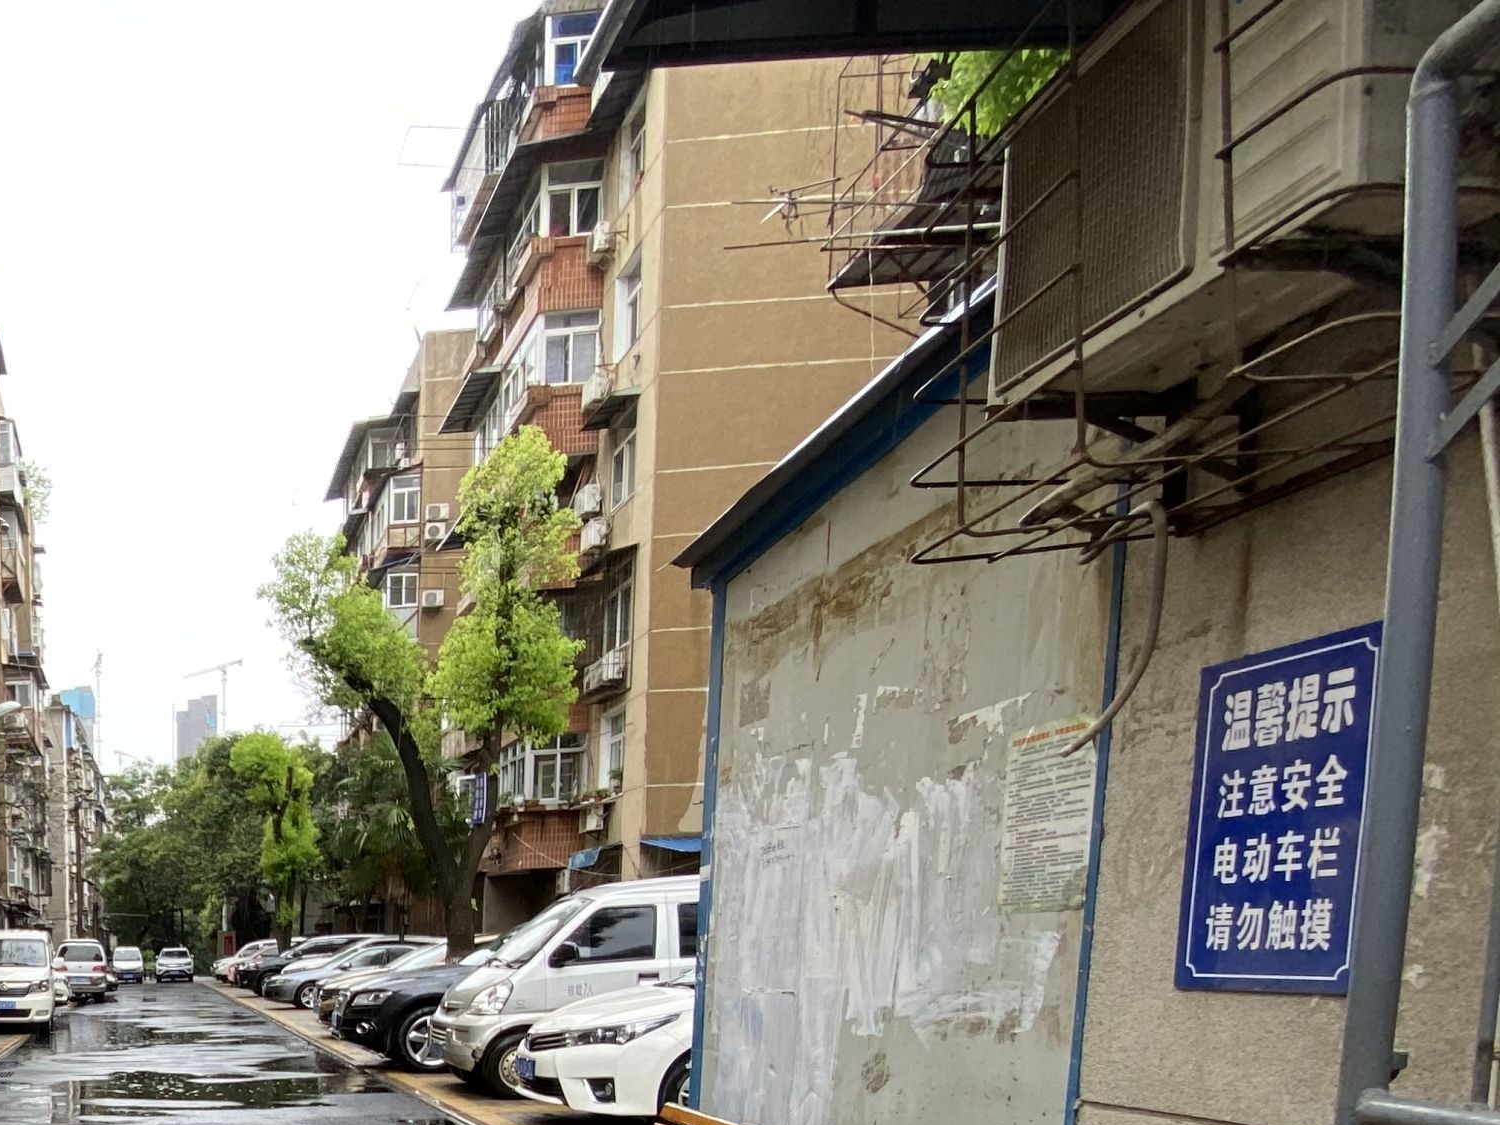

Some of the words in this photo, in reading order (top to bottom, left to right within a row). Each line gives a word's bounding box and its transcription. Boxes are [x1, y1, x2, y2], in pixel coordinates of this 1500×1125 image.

[1221, 667, 1357, 751] 温馨提示
[1216, 755, 1349, 819] 注意安全
[1212, 826, 1342, 885] 电动车栏
[1204, 898, 1334, 952] 请勿触摸
